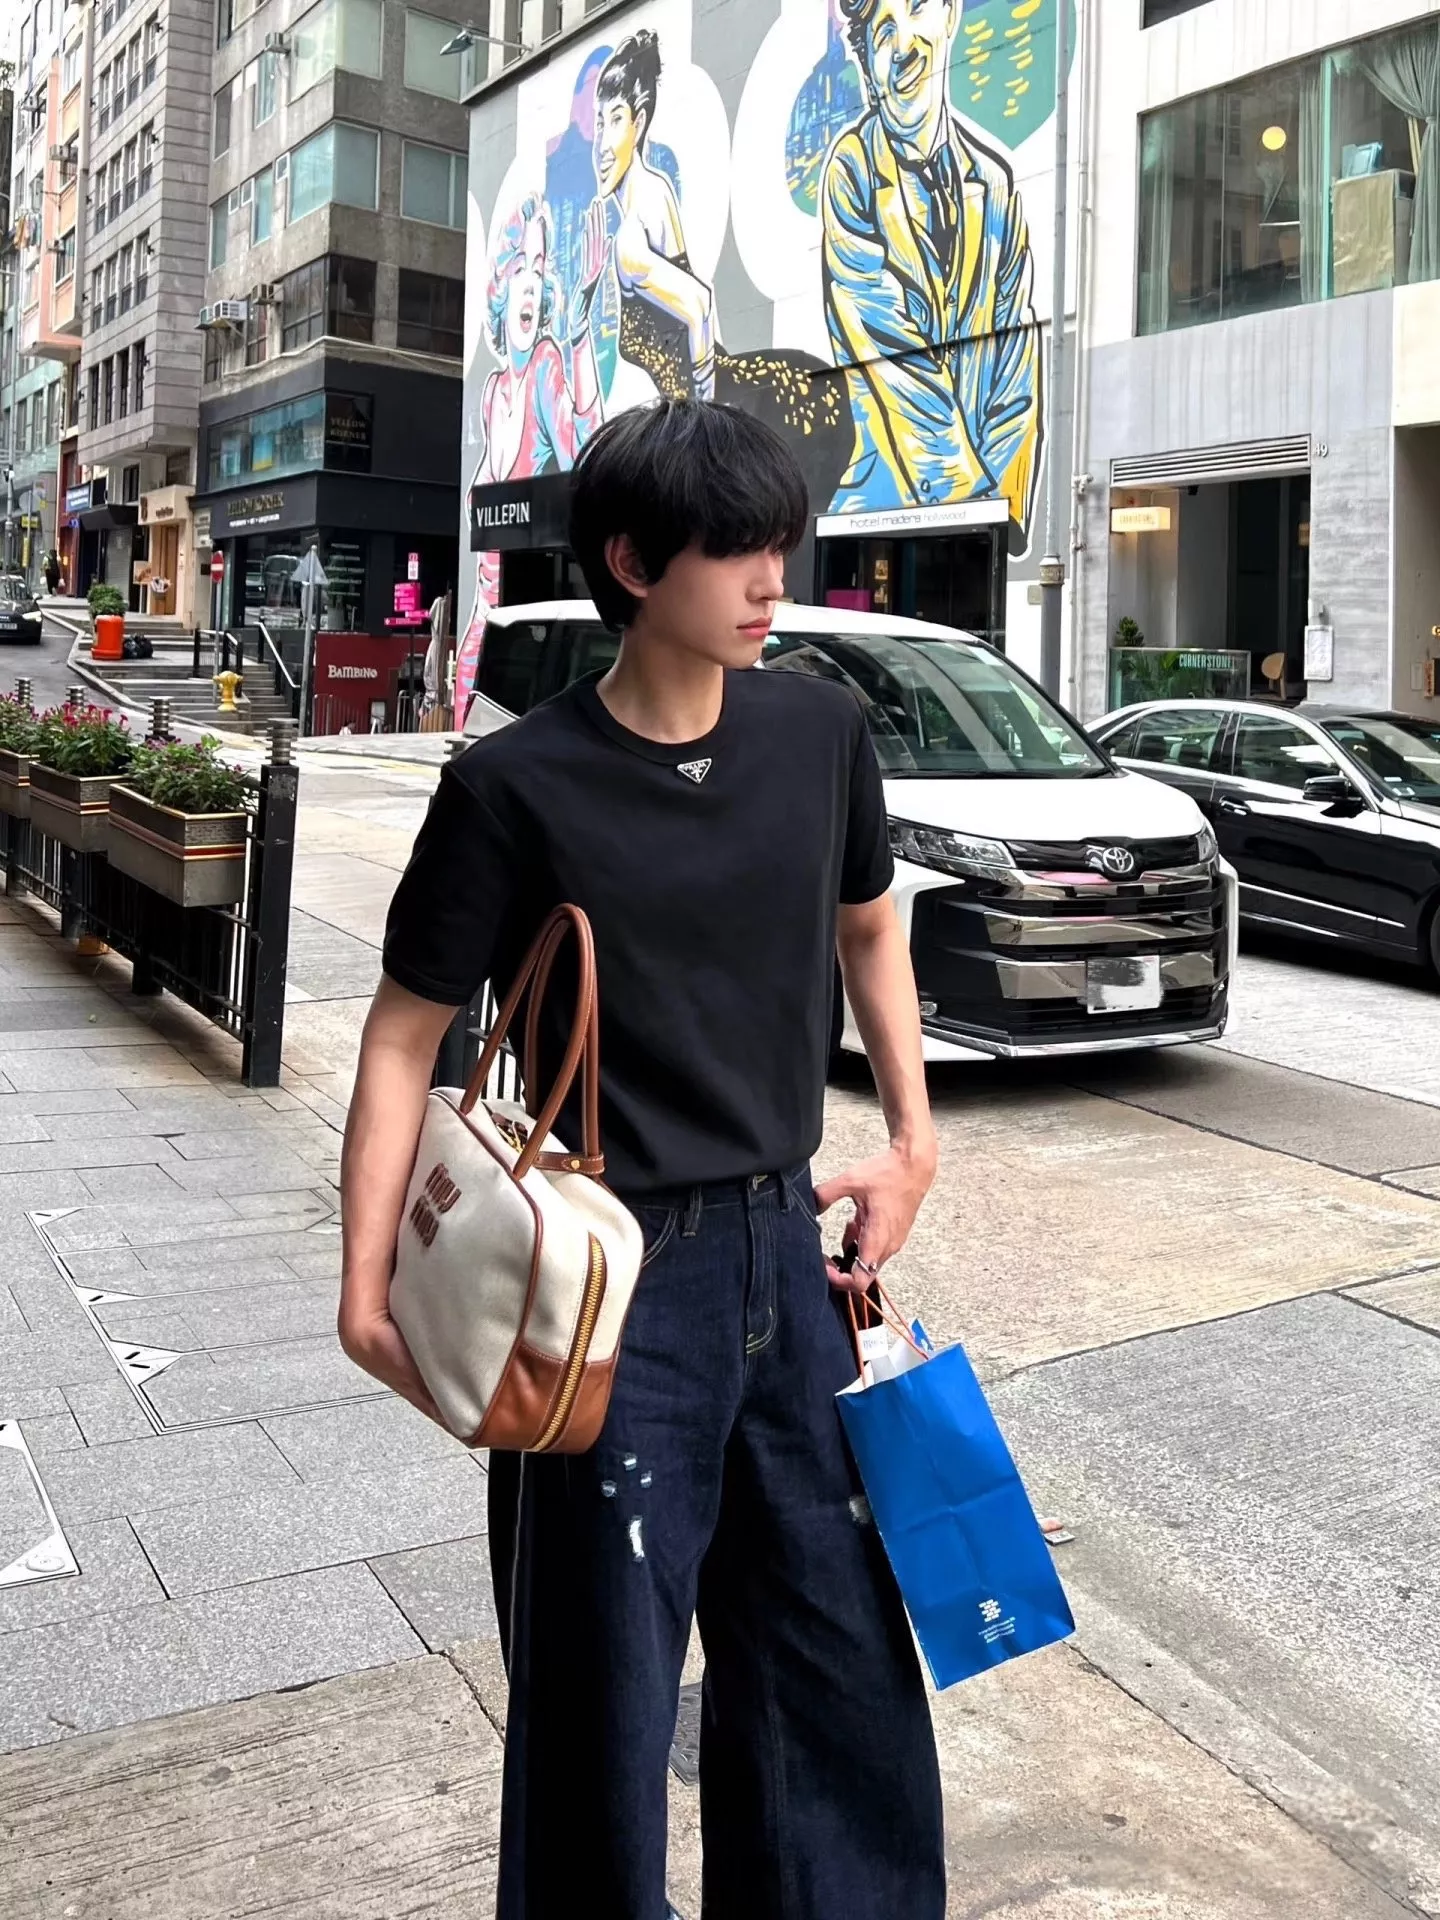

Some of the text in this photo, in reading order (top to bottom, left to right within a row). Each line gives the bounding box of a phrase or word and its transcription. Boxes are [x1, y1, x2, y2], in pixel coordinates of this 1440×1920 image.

[476, 501, 531, 528] VILLEPIN
[850, 515, 880, 529] hotel
[1179, 653, 1232, 669] CORNERSTONE
[327, 664, 379, 679] BAMBINO
